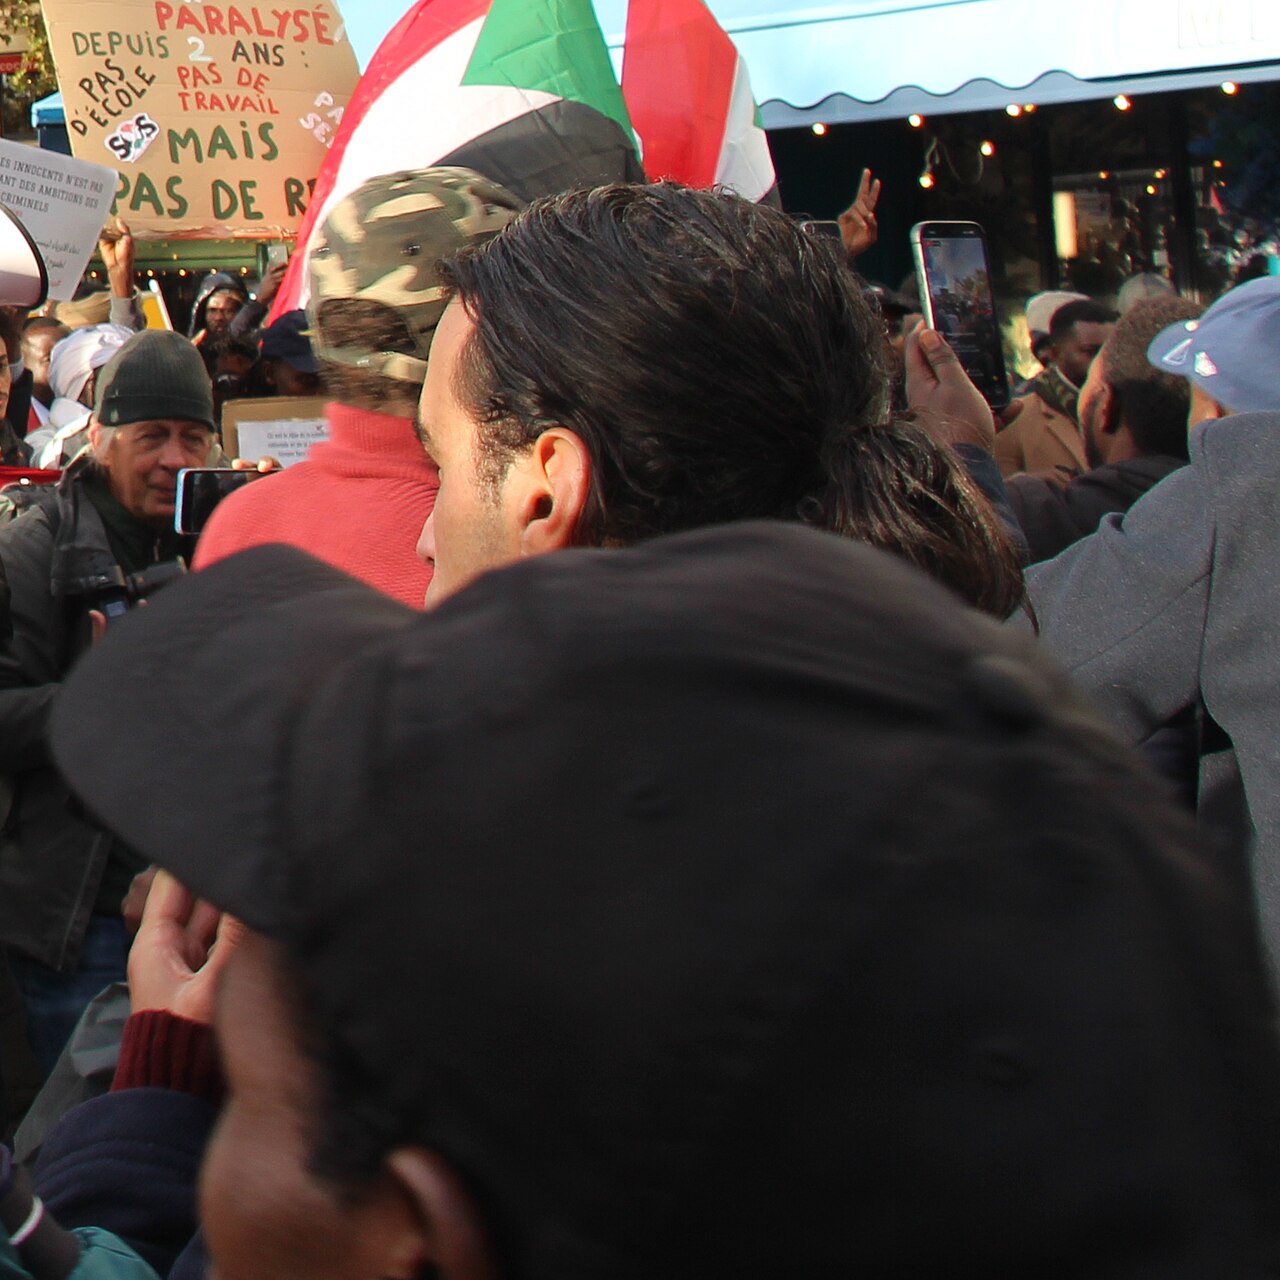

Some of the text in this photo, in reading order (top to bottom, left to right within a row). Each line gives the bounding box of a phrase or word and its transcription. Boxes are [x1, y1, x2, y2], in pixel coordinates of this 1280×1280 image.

[155, 1, 335, 46] PARALYSÉ
[187, 36, 214, 63] 2
[232, 40, 286, 68] ANS
[78, 59, 127, 103] PAS
[177, 62, 270, 94] PAS DE
[13, 160, 64, 183] INNOCENTS
[65, 174, 89, 189] N'EST
[90, 180, 104, 194] PAS
[18, 179, 37, 193] DES
[38, 184, 83, 206] AMBITIONS
[0, 191, 50, 213] CRIMINELS
[212, 178, 264, 221] DE
